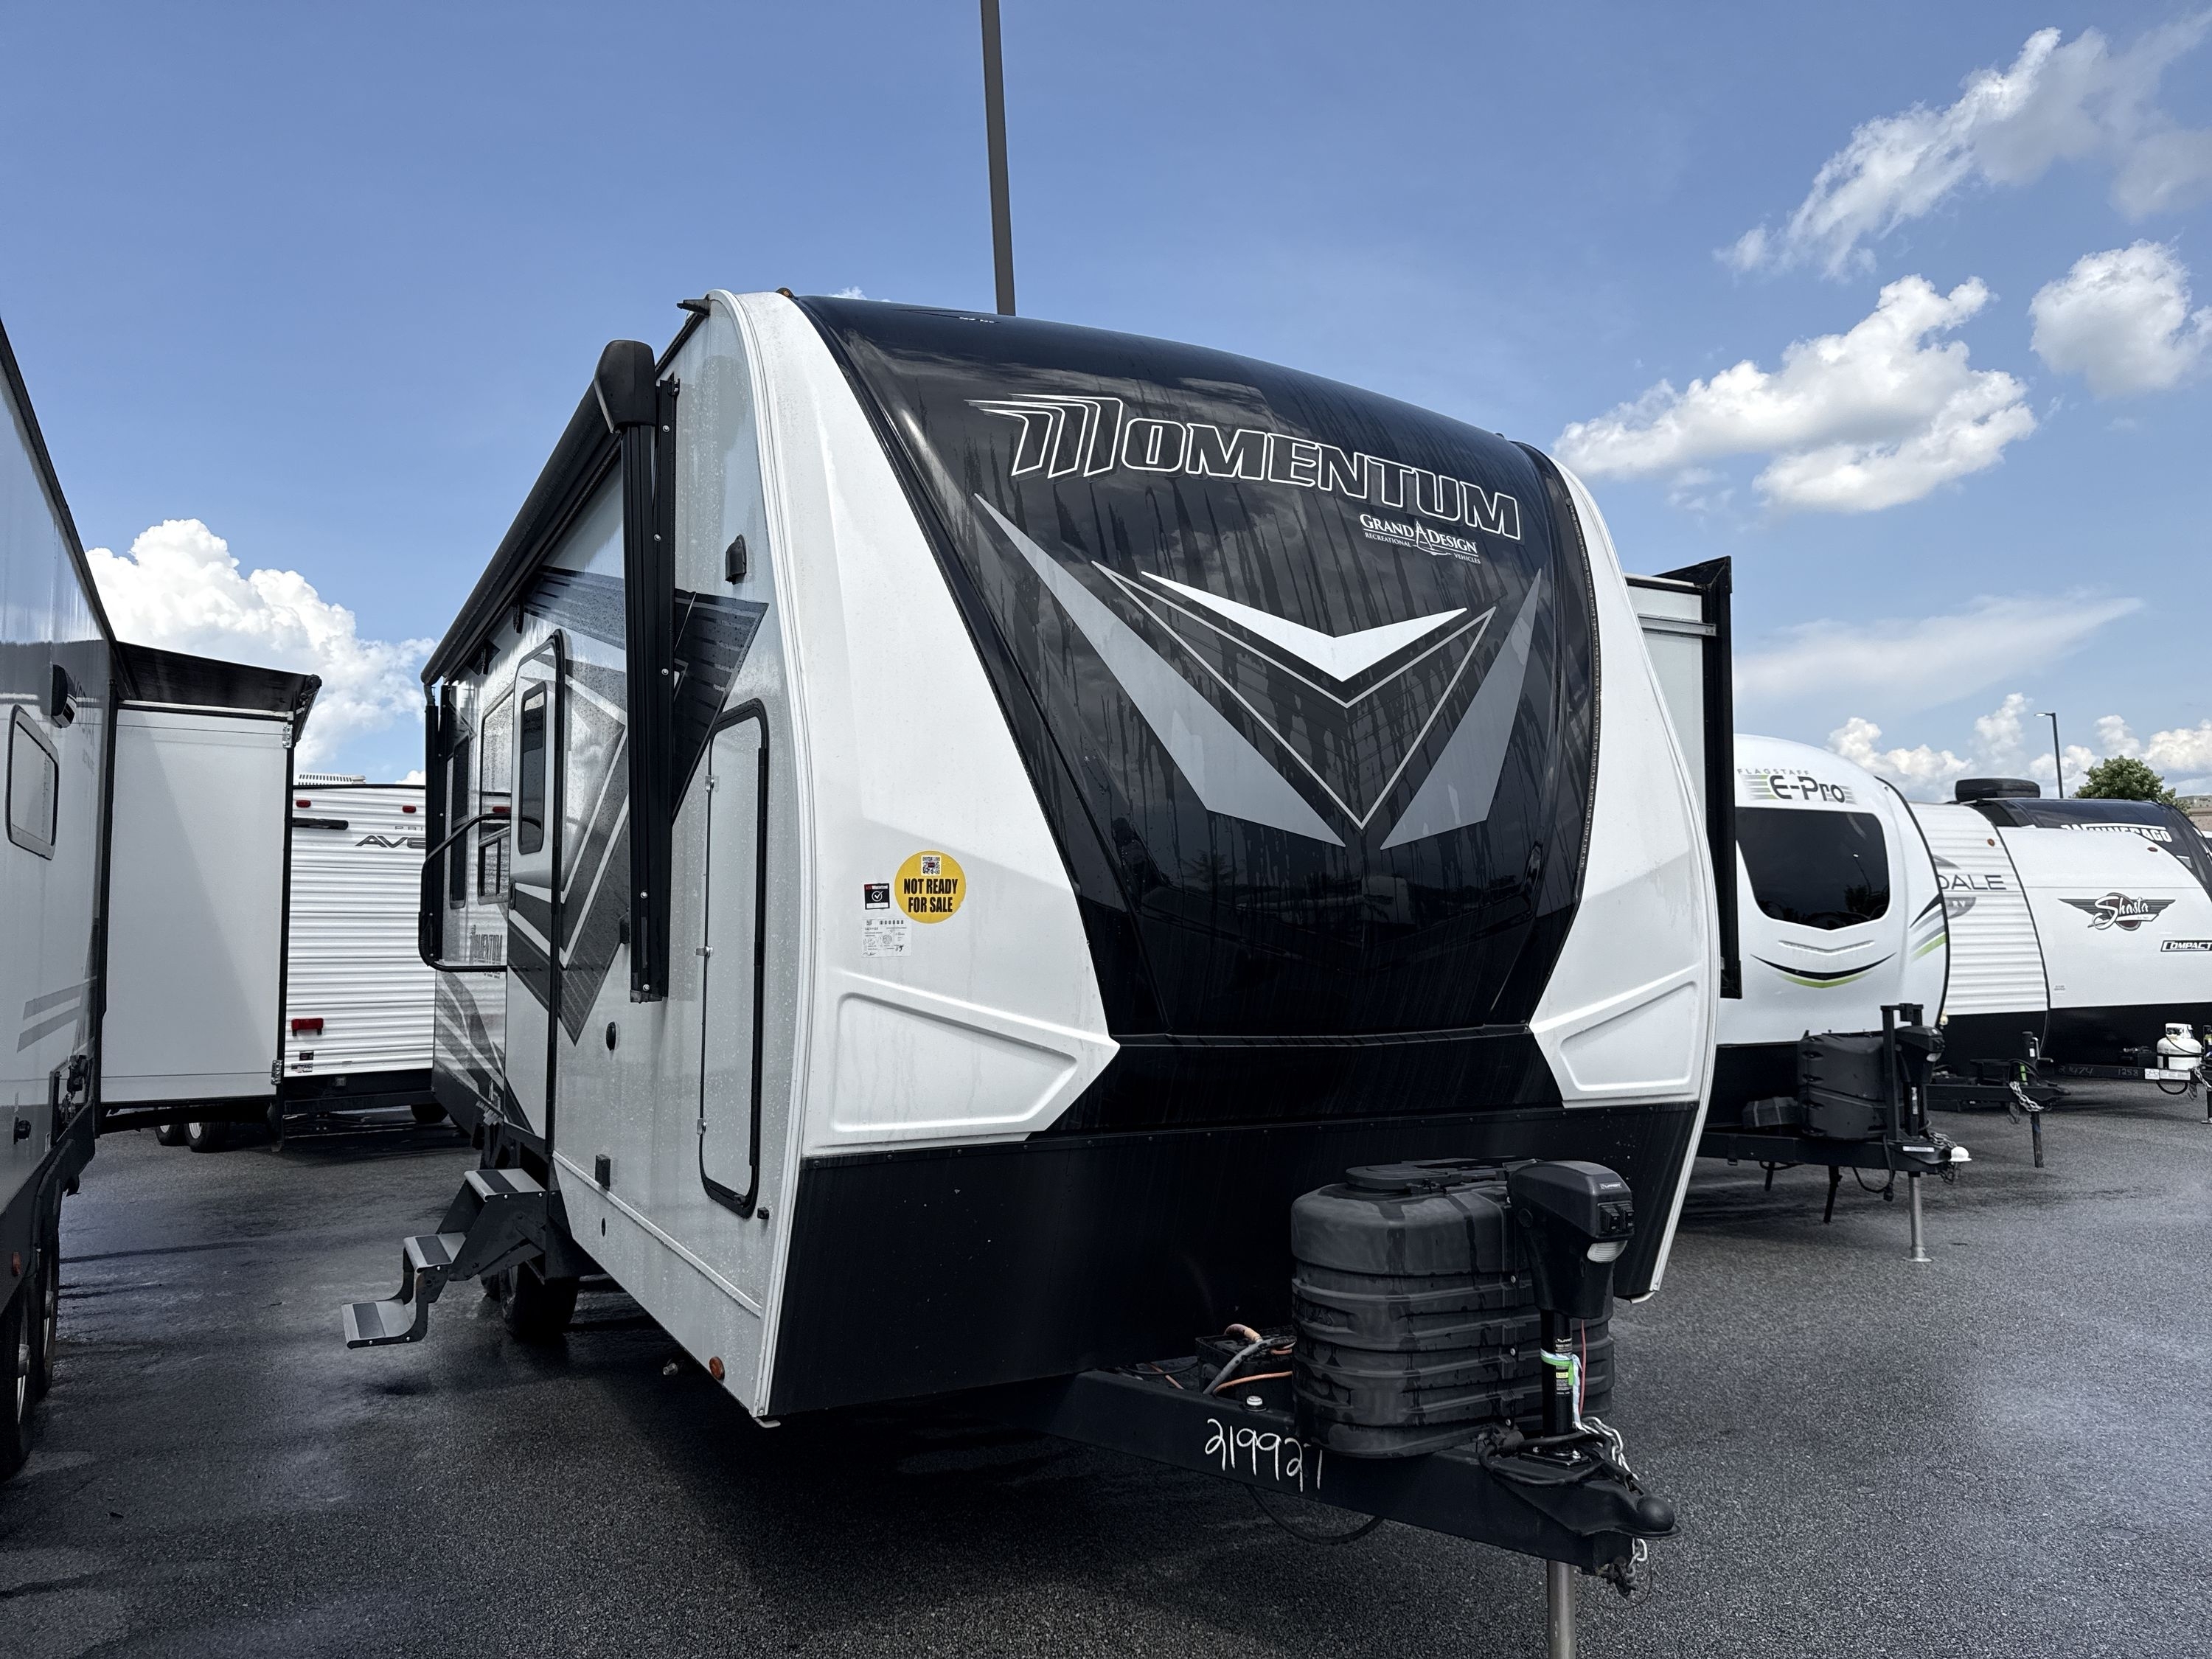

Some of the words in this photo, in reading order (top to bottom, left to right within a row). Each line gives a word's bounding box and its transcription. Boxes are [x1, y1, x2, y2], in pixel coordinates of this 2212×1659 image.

[964, 393, 1521, 540] MOMENTUM
[1360, 513, 1414, 538] GRAND
[1426, 529, 1478, 554] DESIGN
[1365, 532, 1412, 548] RECREATIONAL
[1453, 553, 1481, 564] VEHICLES
[903, 878, 924, 894] NOT
[926, 878, 959, 894] READY
[908, 897, 928, 913] FOR
[929, 897, 953, 913] SALE
[2092, 895, 2149, 930] Shasta
[2161, 941, 2212, 951] COMPACT
